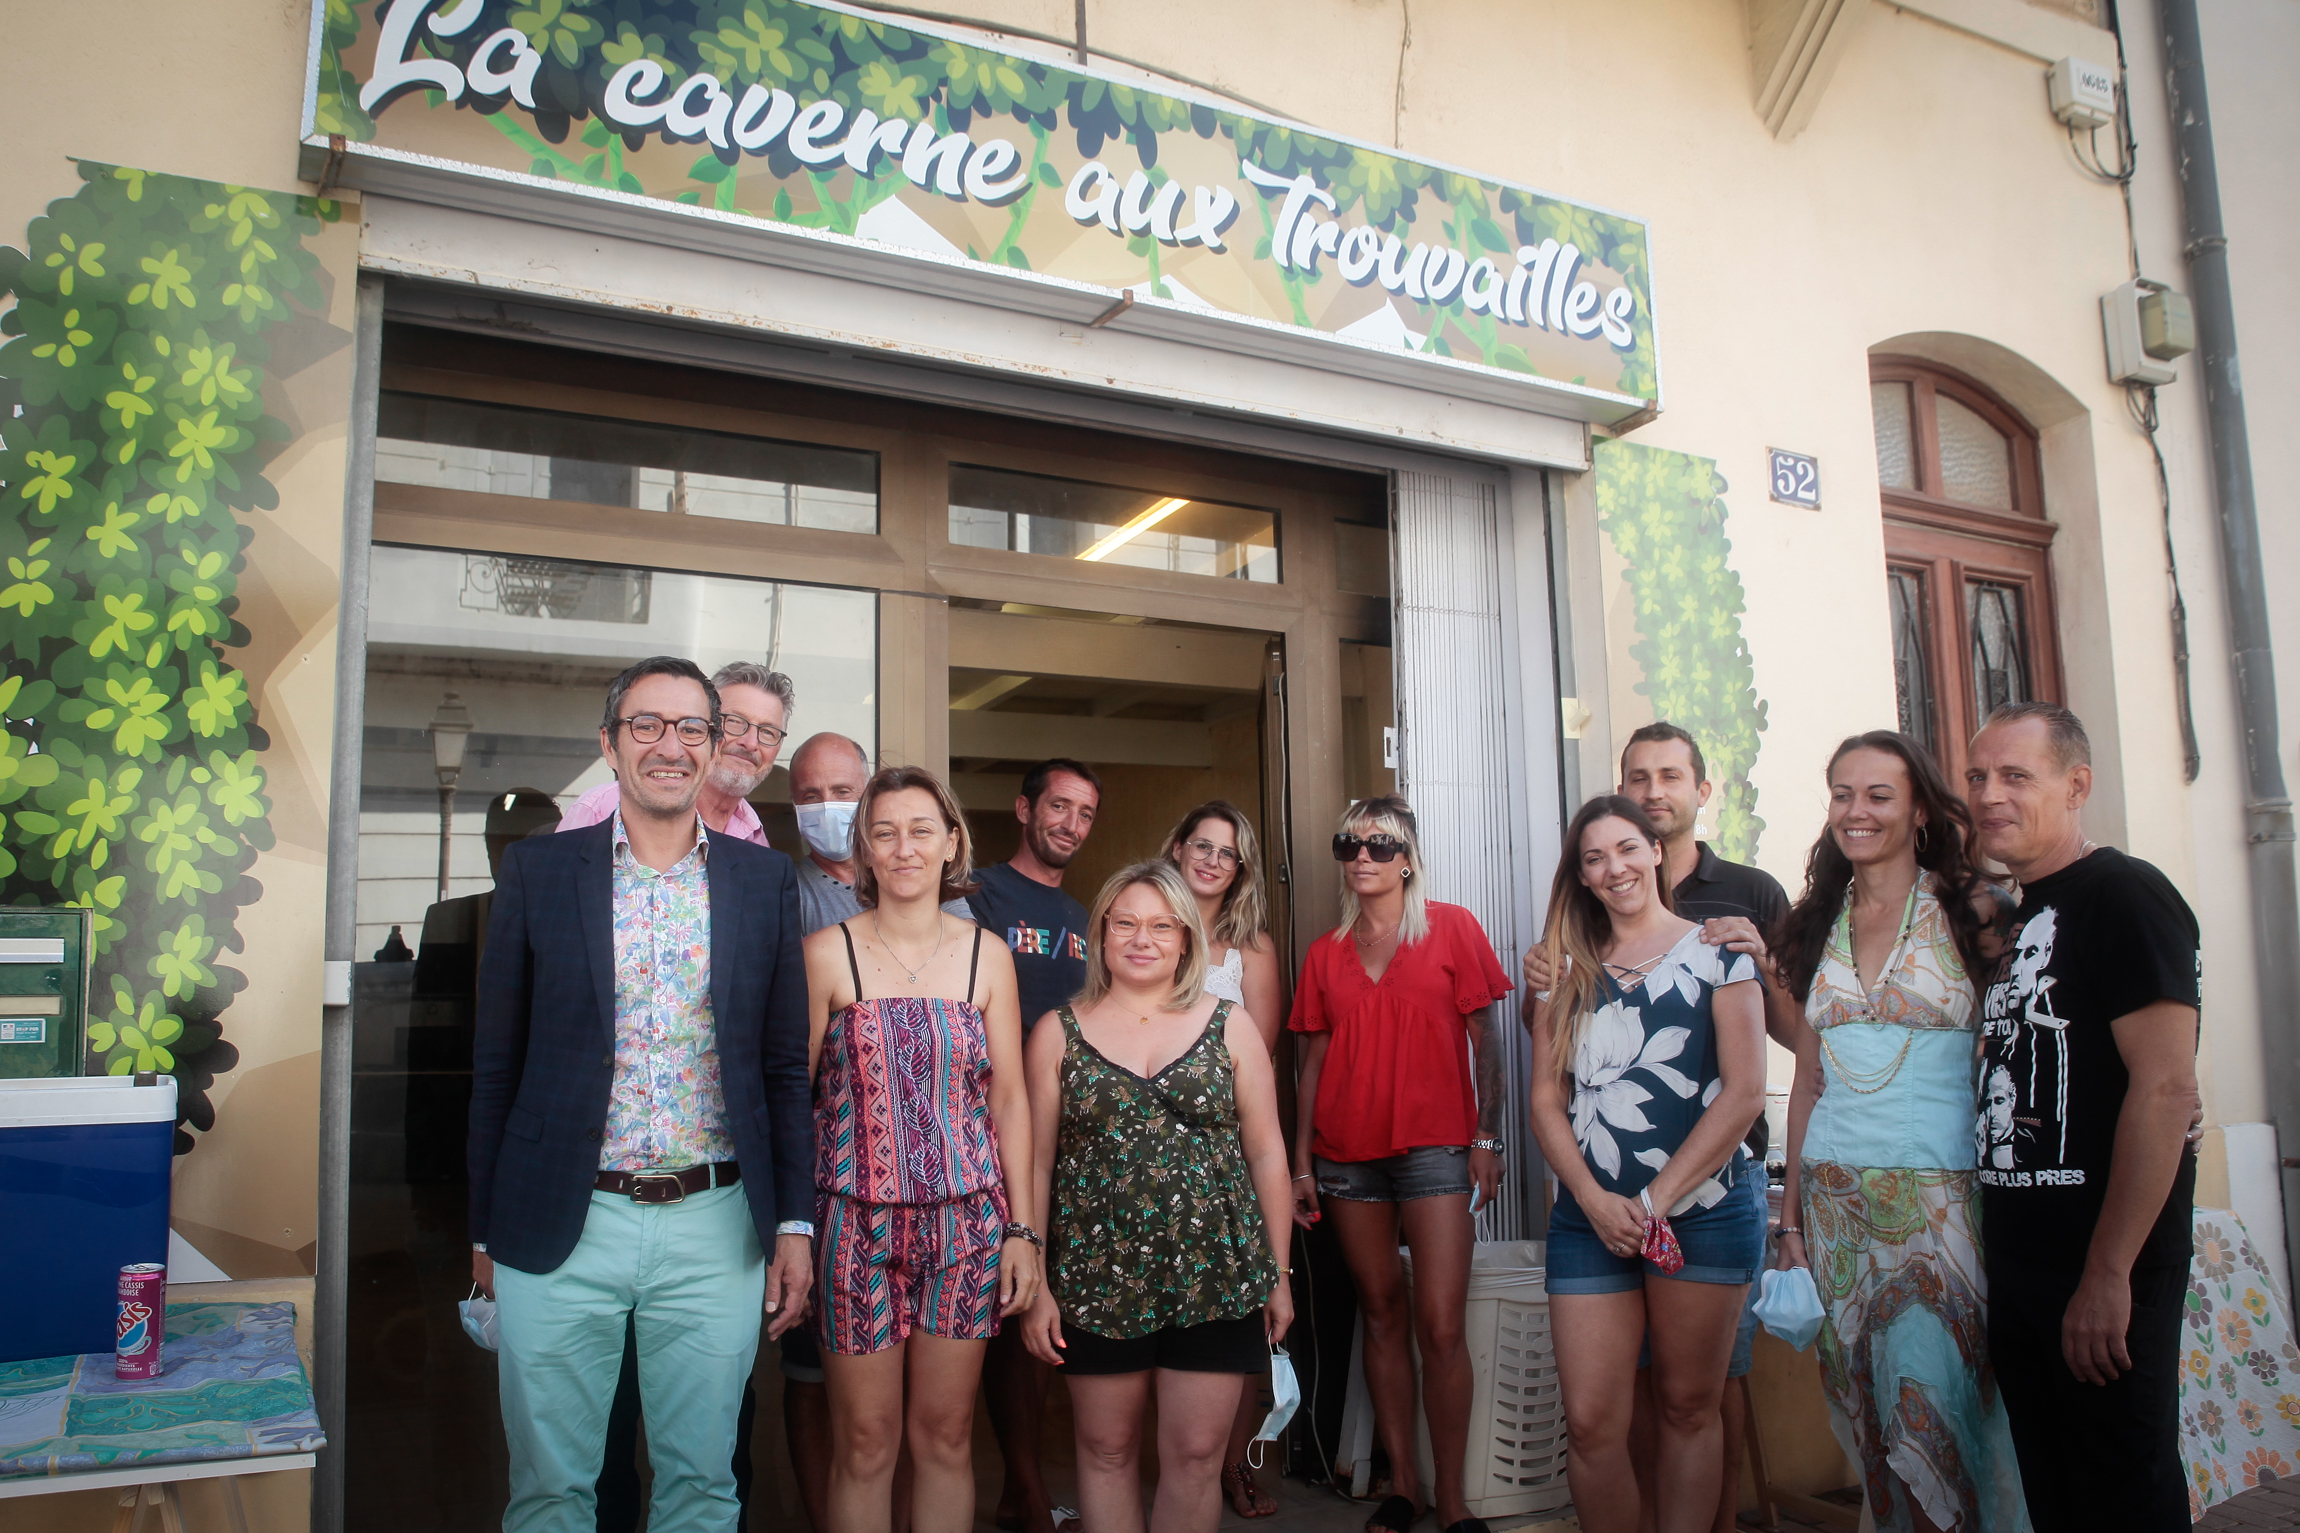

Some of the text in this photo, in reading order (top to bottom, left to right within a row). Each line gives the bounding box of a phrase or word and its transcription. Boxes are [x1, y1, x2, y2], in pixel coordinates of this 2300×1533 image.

[359, 0, 1635, 348] La caverne aux Trouvailles
[1775, 456, 1816, 501] 52
[1998, 1171, 2033, 1188] PLUS
[124, 1281, 145, 1290] CASSIS
